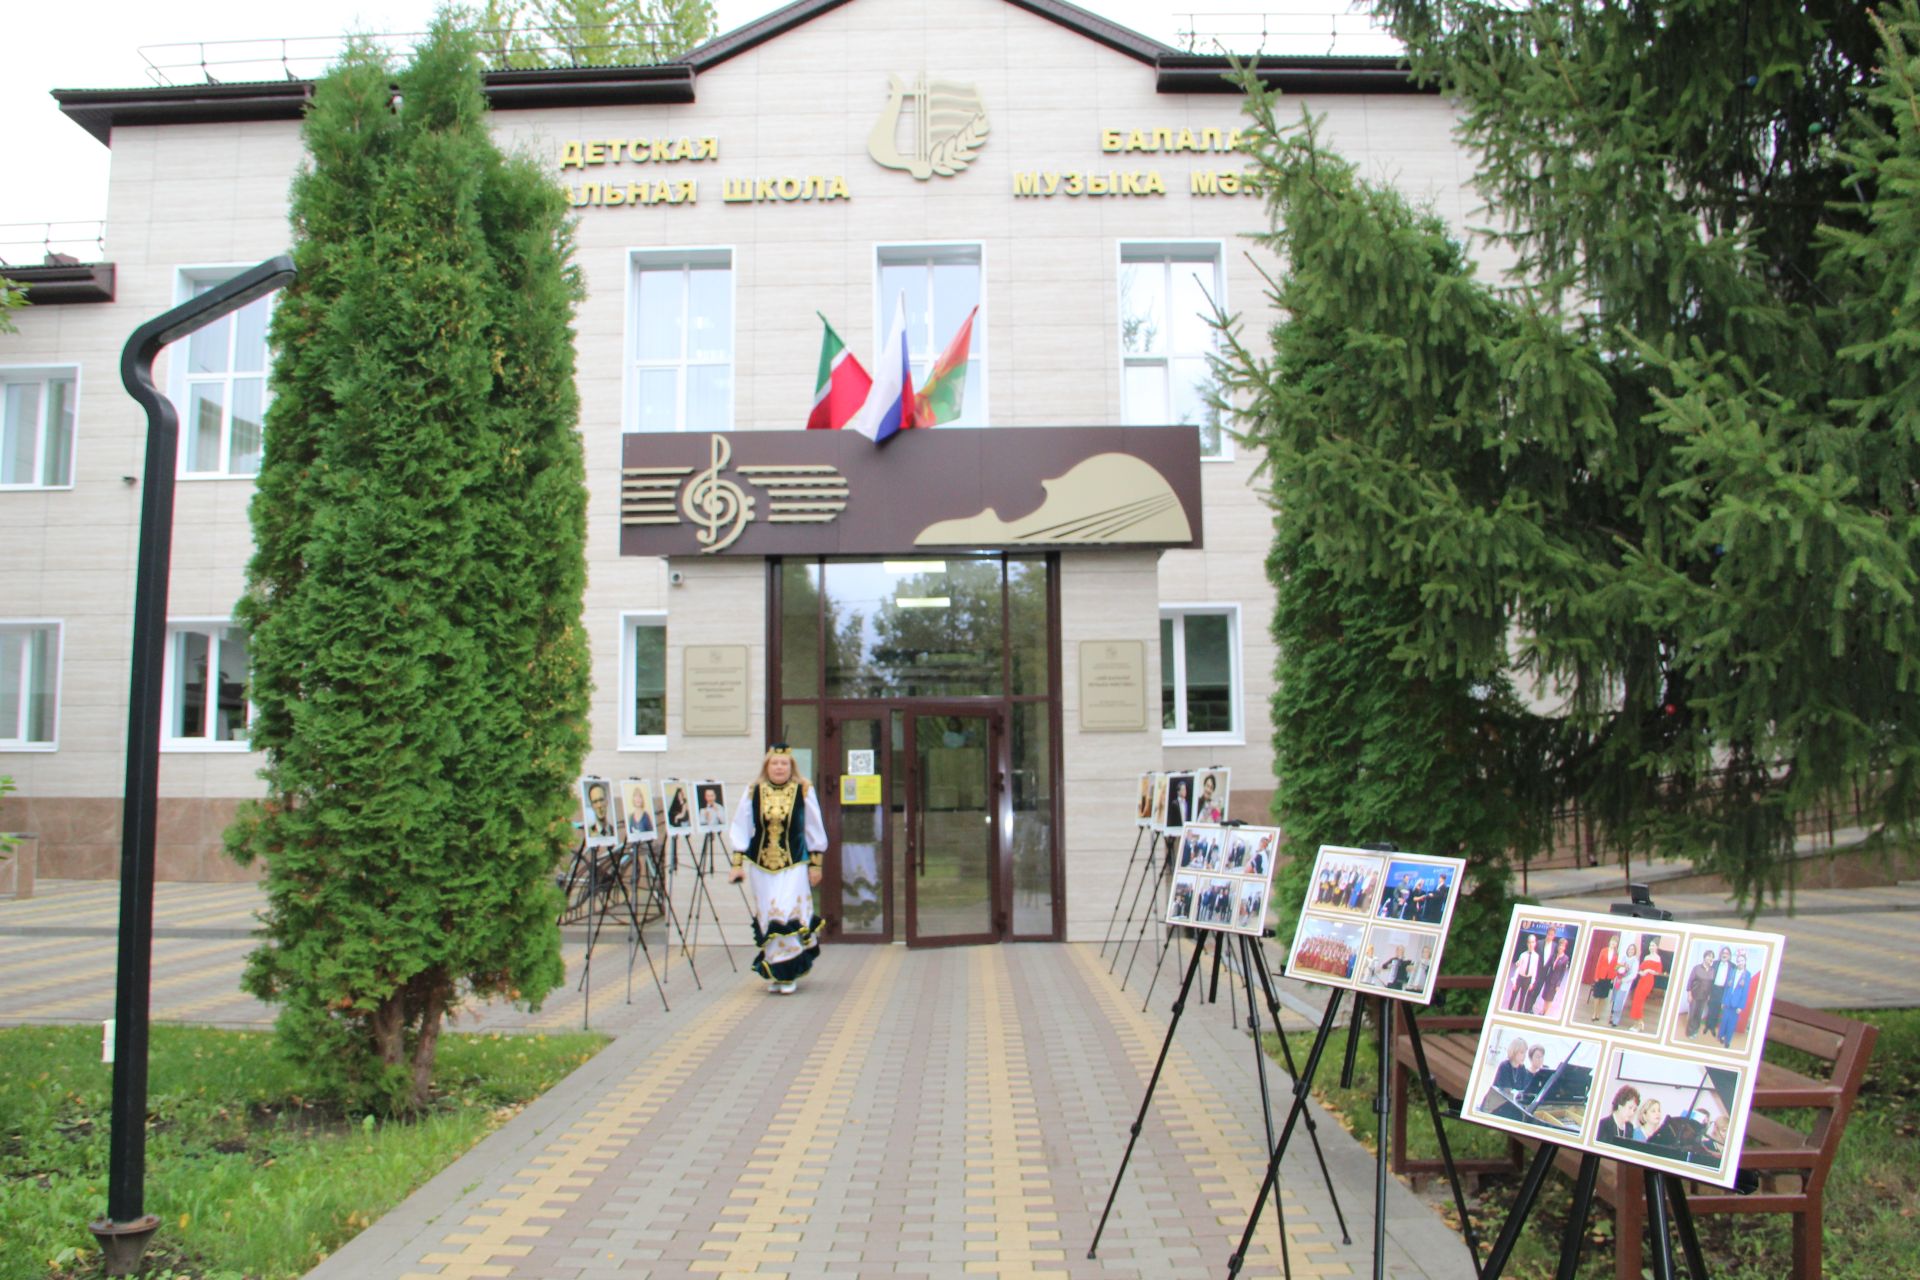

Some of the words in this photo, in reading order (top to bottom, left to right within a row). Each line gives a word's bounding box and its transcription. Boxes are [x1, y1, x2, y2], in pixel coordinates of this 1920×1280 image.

[559, 136, 719, 170] ДЕТСКАЯ
[722, 174, 851, 203] ШКОЛА
[1012, 170, 1167, 197] МУЗЫКА
